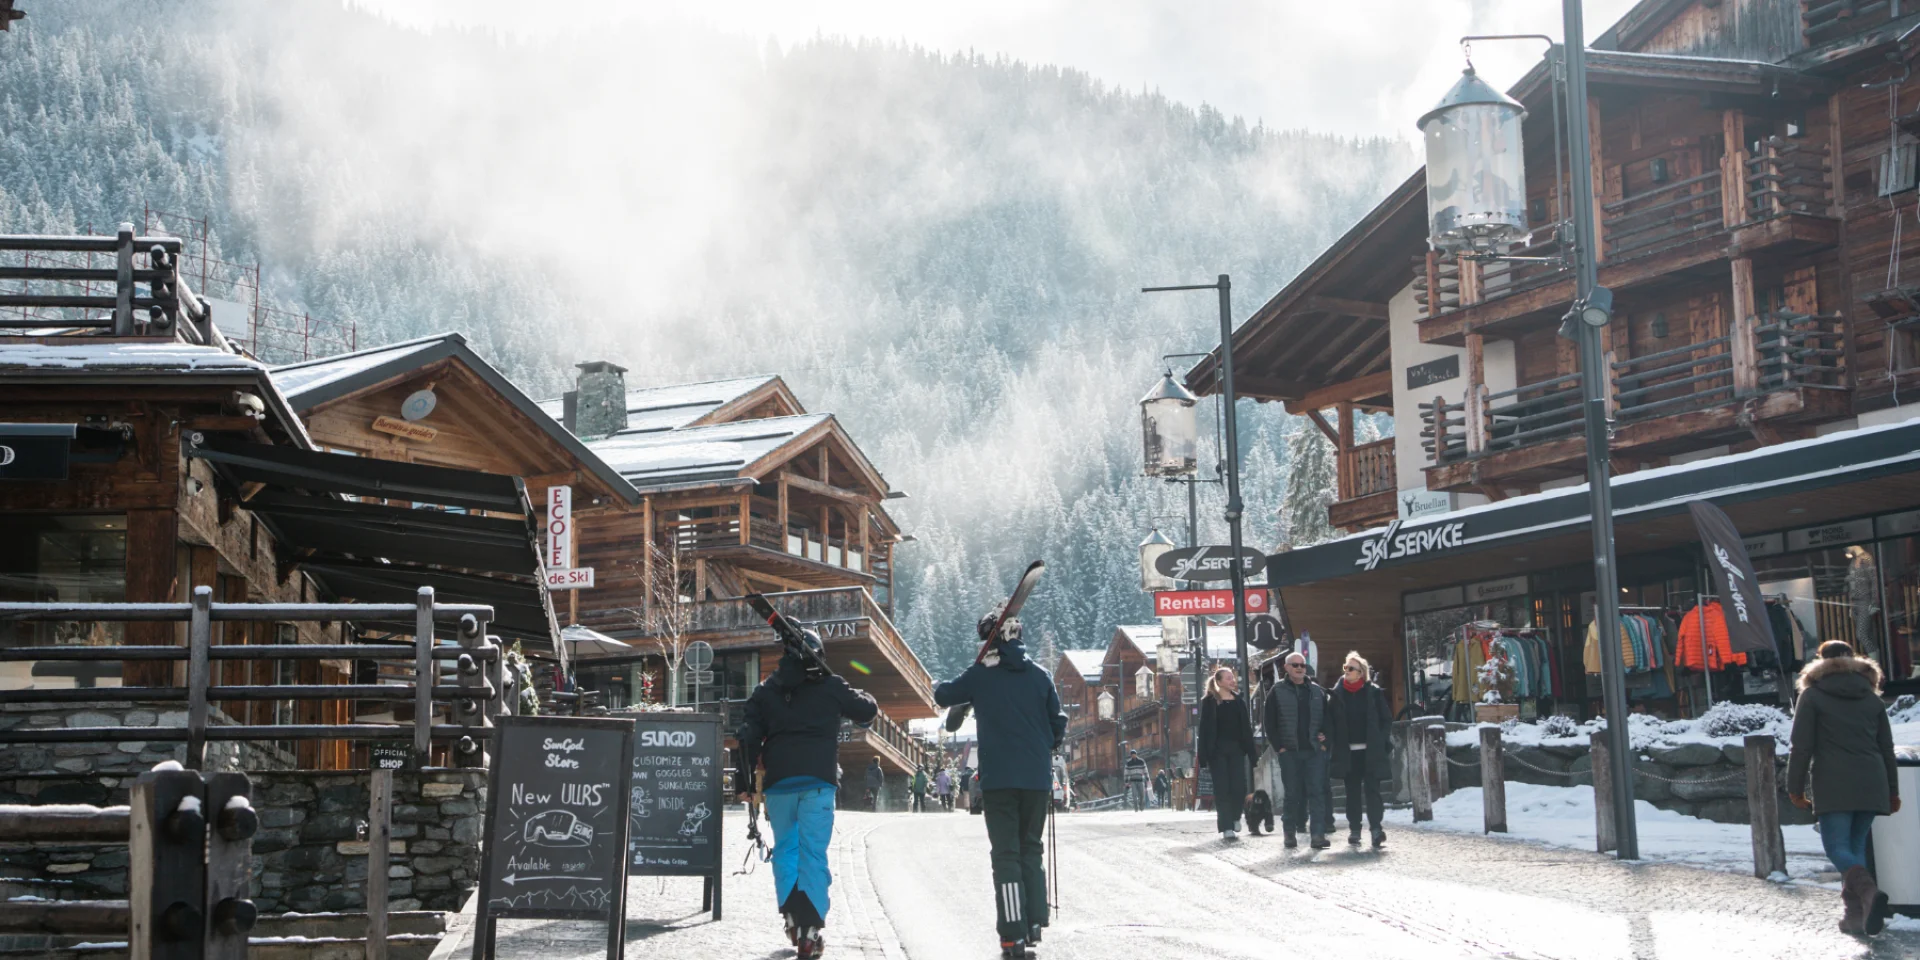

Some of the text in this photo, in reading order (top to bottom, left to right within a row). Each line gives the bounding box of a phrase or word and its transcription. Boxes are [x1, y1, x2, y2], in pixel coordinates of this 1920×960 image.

[407, 427, 434, 439] guides
[1414, 498, 1447, 512] Bruellan
[550, 489, 566, 566] ECOLE
[1389, 522, 1465, 559] SERVICE
[548, 571, 589, 585] de Ski
[1160, 595, 1226, 610] Rentals
[641, 731, 696, 747] SUNGOD
[374, 749, 407, 757] OFFICIAL
[380, 759, 403, 768] SHOP
[545, 753, 580, 769] Store
[691, 756, 711, 766] YOUR
[655, 769, 692, 778] GOGGLES
[658, 781, 707, 791] SUNGLASSES
[512, 783, 551, 805] New
[658, 796, 685, 810] INSIDE
[507, 855, 551, 871] Available
